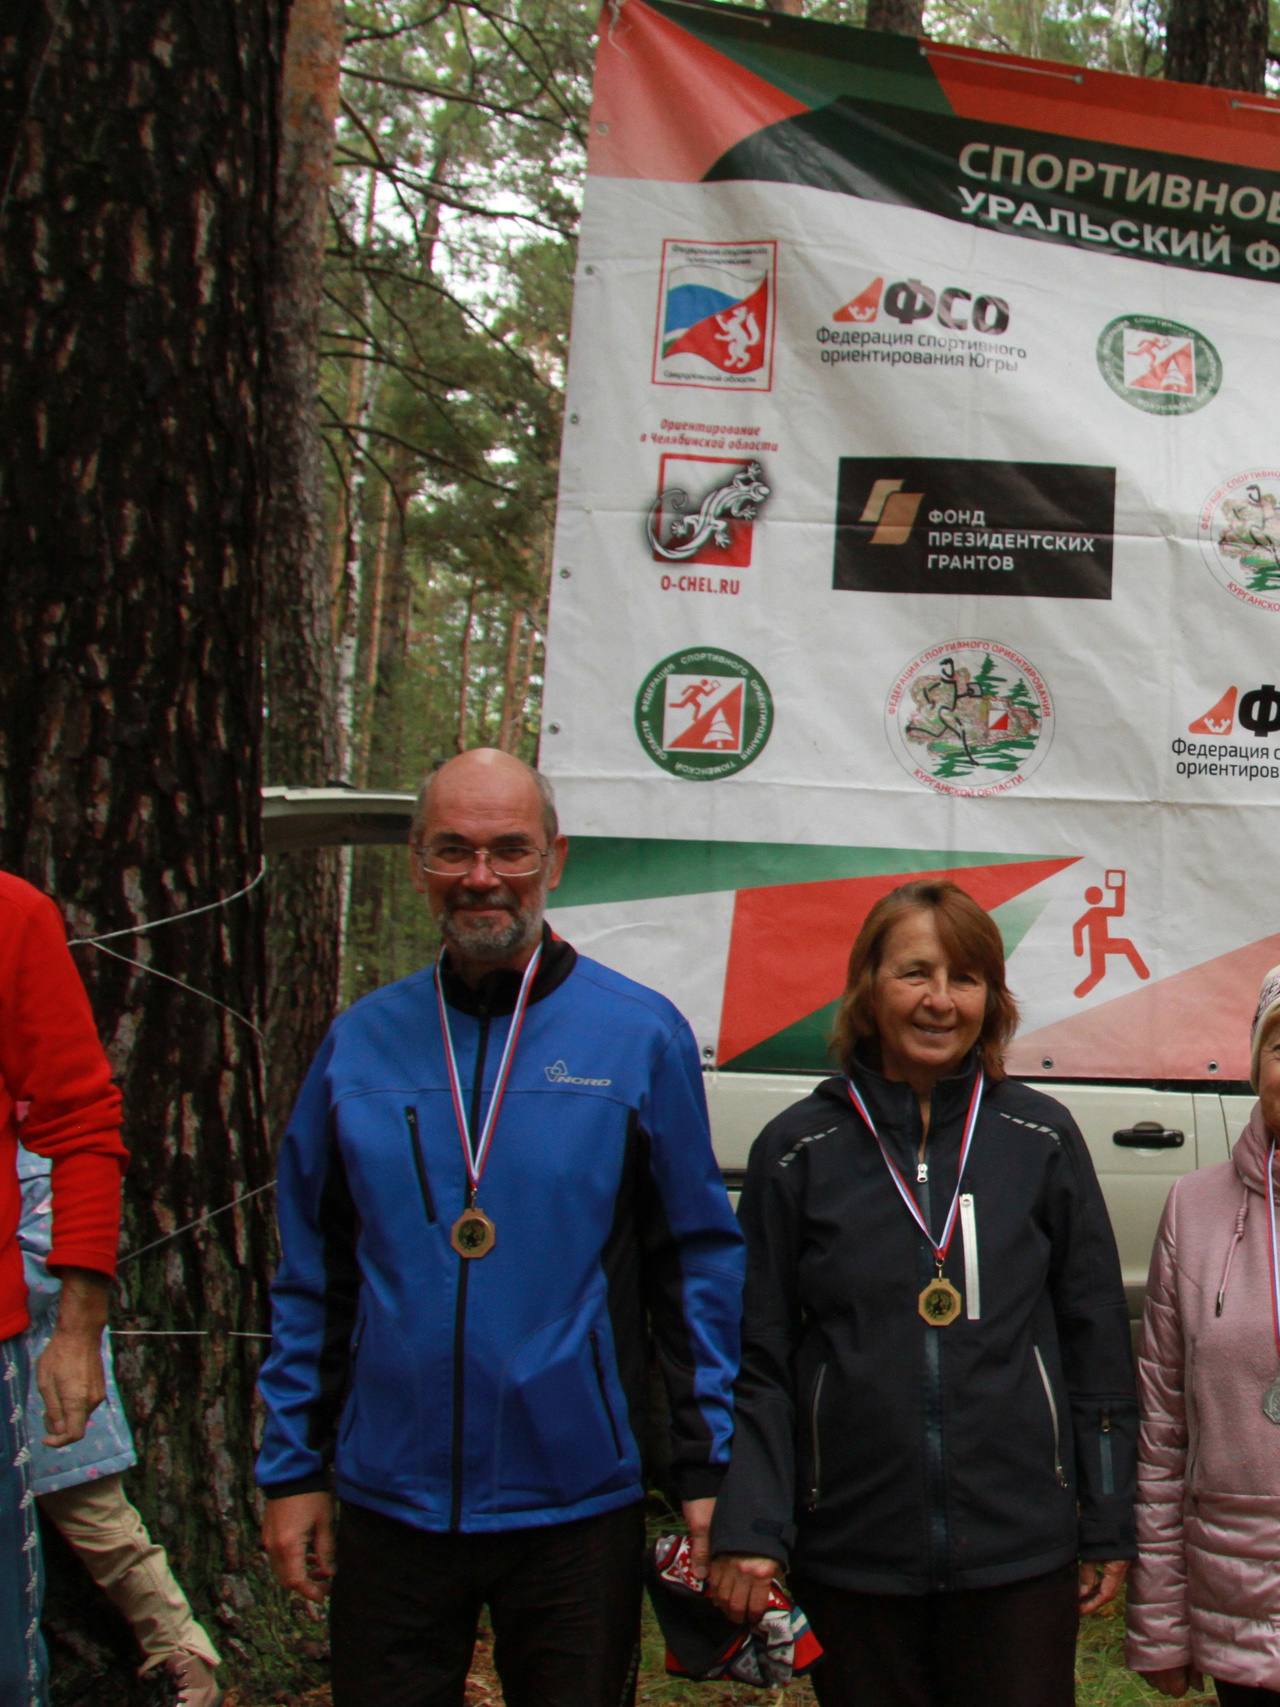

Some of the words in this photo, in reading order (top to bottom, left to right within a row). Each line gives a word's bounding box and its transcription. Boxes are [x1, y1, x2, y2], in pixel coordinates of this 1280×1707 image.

[958, 186, 1231, 265] УРАЛЬСКИЙ
[883, 278, 1010, 335] ФСО
[816, 326, 914, 347] Федерация
[918, 333, 1027, 359] спортивного
[821, 349, 964, 367] ориентирования
[969, 352, 1018, 373] Югры
[660, 419, 761, 436] Ориентирование
[651, 433, 725, 449] Челябинской
[928, 510, 986, 527] ФОНД
[928, 532, 1095, 552] ПРЕЗИДЕНТСКИХ
[927, 555, 1015, 571] ГРАНТОВ
[680, 652, 749, 675] СПОРТИВНОГО
[641, 663, 675, 712] ФЕДЕРАЦИЯ
[888, 661, 920, 715] ФЕДЕРАЦИЯ
[921, 641, 990, 664] СПОРТИВНОГО
[991, 645, 1051, 717] ОРИЕНТИРОВАНИЯ
[740, 679, 768, 760] ОРИЕНТИРОВАНИЯ
[641, 720, 667, 760] ОБЛАСТИ
[1172, 738, 1269, 761] Федерация
[674, 761, 736, 775] ТЮМЕНСКОЙ
[914, 769, 974, 797] КУРГАНСКОЙ
[978, 774, 1024, 797] ОБЛАСТИ
[557, 1076, 611, 1086] NORD
